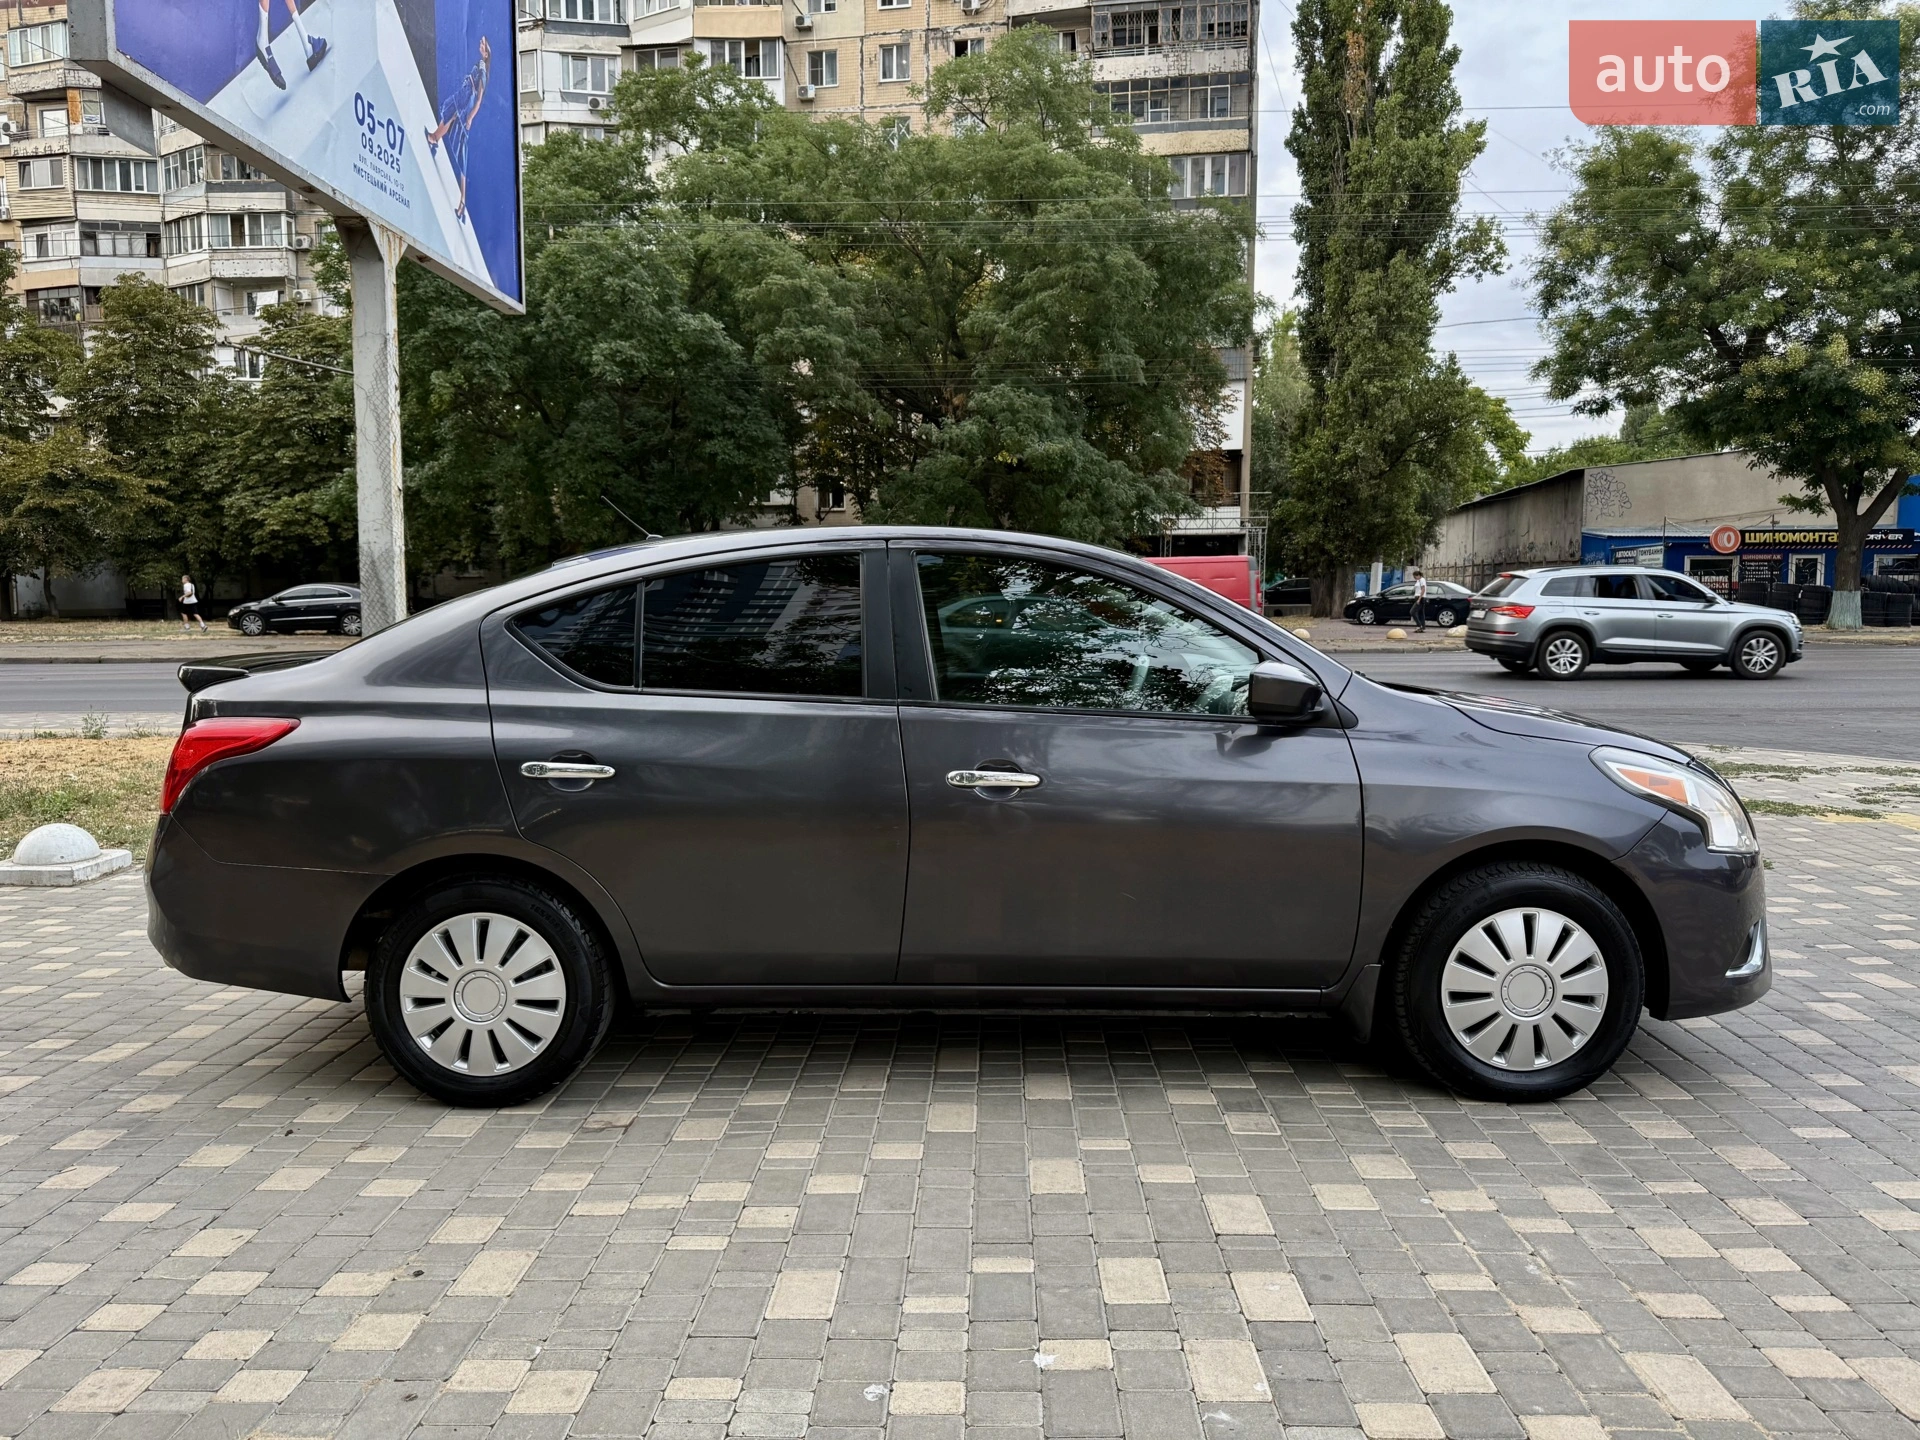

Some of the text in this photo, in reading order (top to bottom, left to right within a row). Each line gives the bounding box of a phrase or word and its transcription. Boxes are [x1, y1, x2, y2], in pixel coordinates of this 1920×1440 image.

[354, 92, 405, 156] 05-07
[361, 132, 401, 174] 09.2025
[352, 162, 410, 209] МИСТЕЦЬКИЙ АРСЕНАЛ
[1745, 532, 1839, 543] шиномонта
